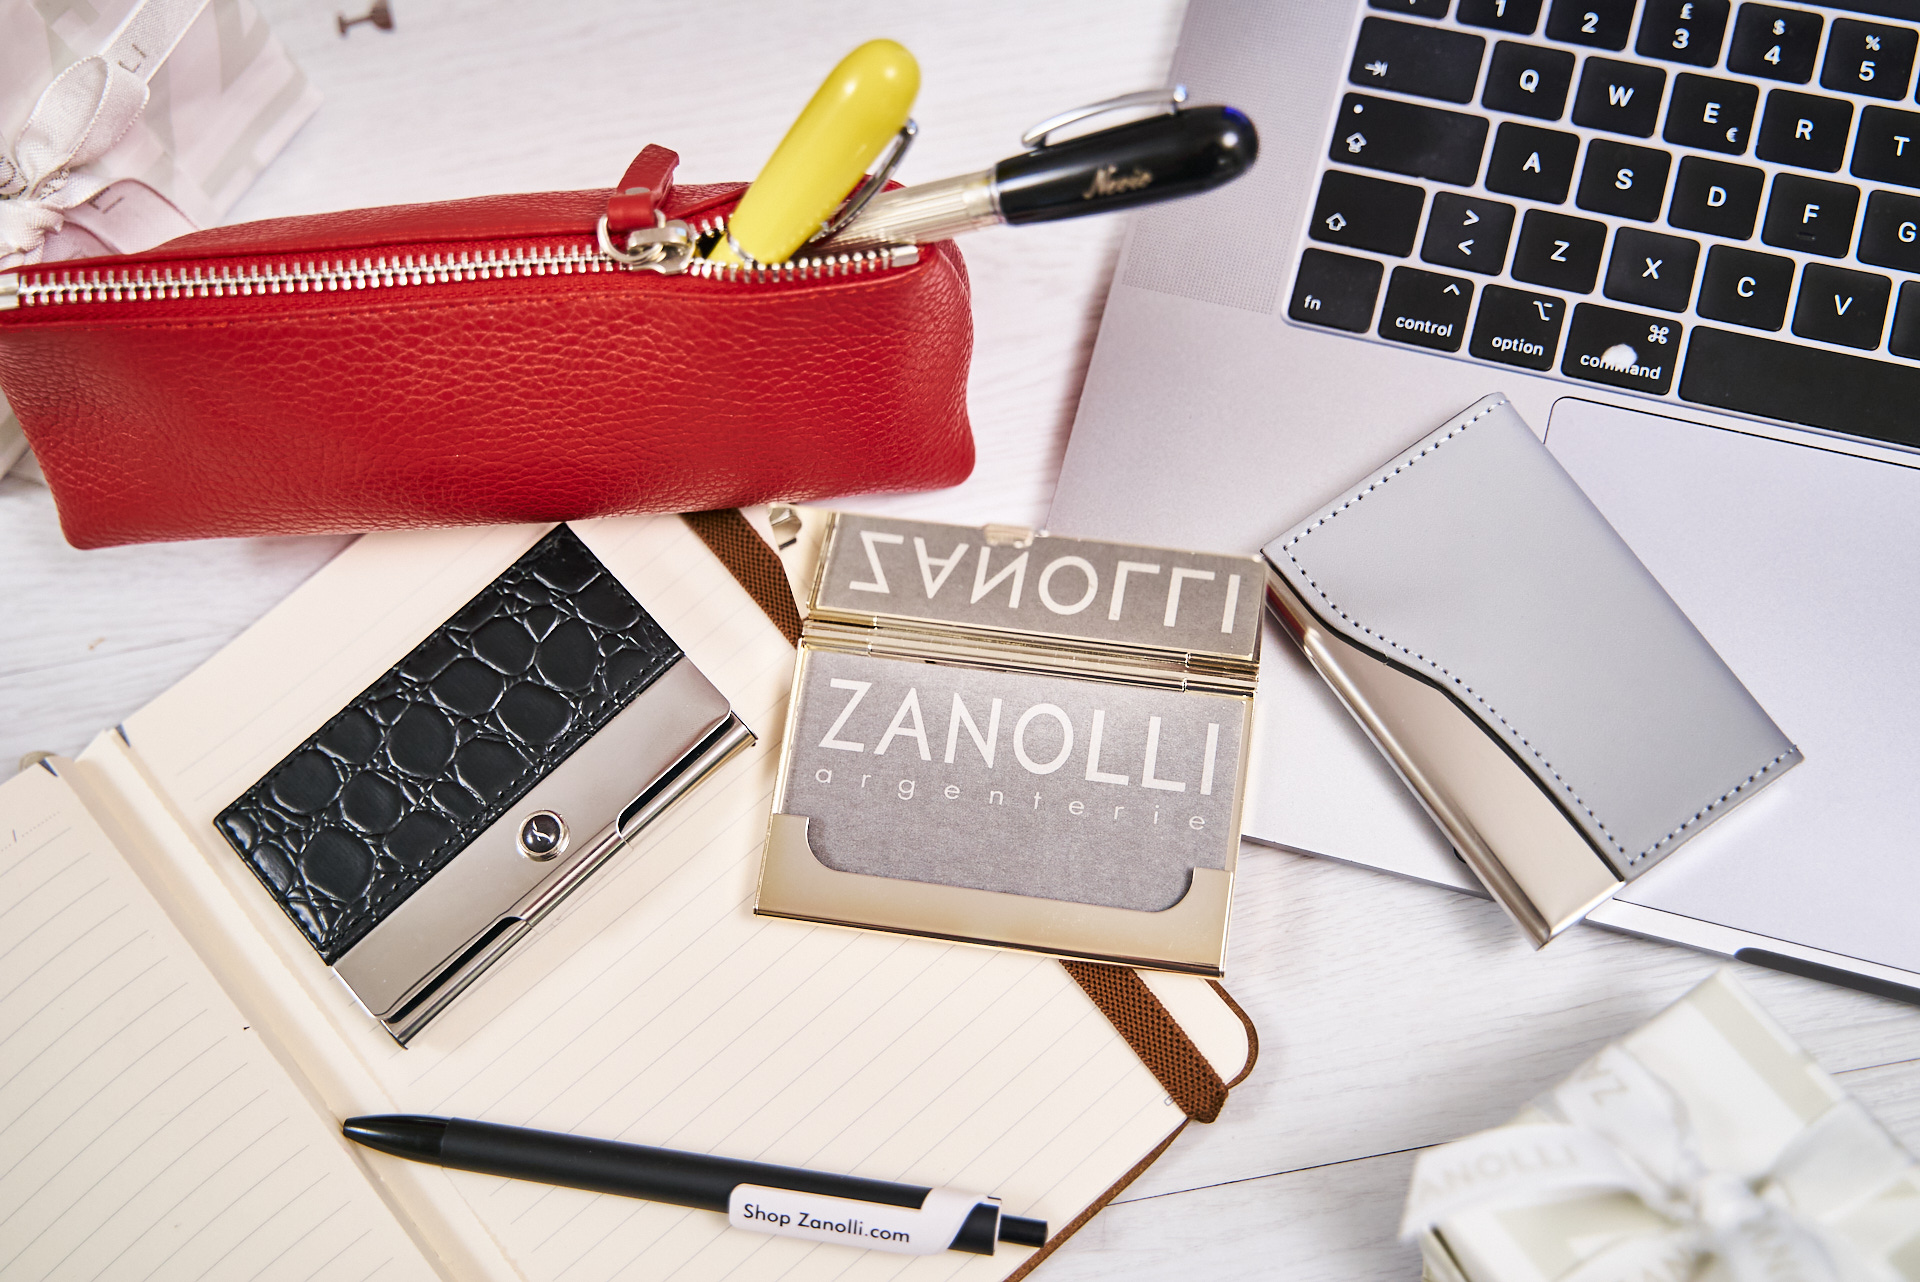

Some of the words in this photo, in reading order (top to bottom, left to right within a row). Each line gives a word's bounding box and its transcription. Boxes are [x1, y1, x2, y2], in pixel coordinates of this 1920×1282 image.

[1495, 0, 1507, 18] 1
[1581, 12, 1600, 34] 2
[1672, 28, 1690, 50] 3
[1763, 45, 1782, 66] 4
[1519, 69, 1540, 93] Q
[1858, 61, 1876, 82] 5
[1608, 84, 1635, 108] W
[1703, 102, 1721, 124] E
[1795, 119, 1814, 141] R
[1893, 135, 1911, 157] T
[1522, 151, 1542, 174] A
[1615, 168, 1634, 190] S
[1706, 186, 1727, 207] D
[1802, 203, 1820, 224] F
[1897, 221, 1918, 243] G
[1550, 239, 1570, 262] Z
[1641, 257, 1663, 280] X
[1737, 276, 1756, 298] C
[1303, 294, 1322, 312] fn
[1834, 294, 1853, 316] V
[1395, 315, 1454, 338] control
[1491, 336, 1545, 357] option
[818, 677, 1220, 796] ZANOLLI
[814, 766, 1207, 831] argenterie
[743, 1203, 792, 1228] Shop
[797, 1211, 911, 1244] Zanolli.com
